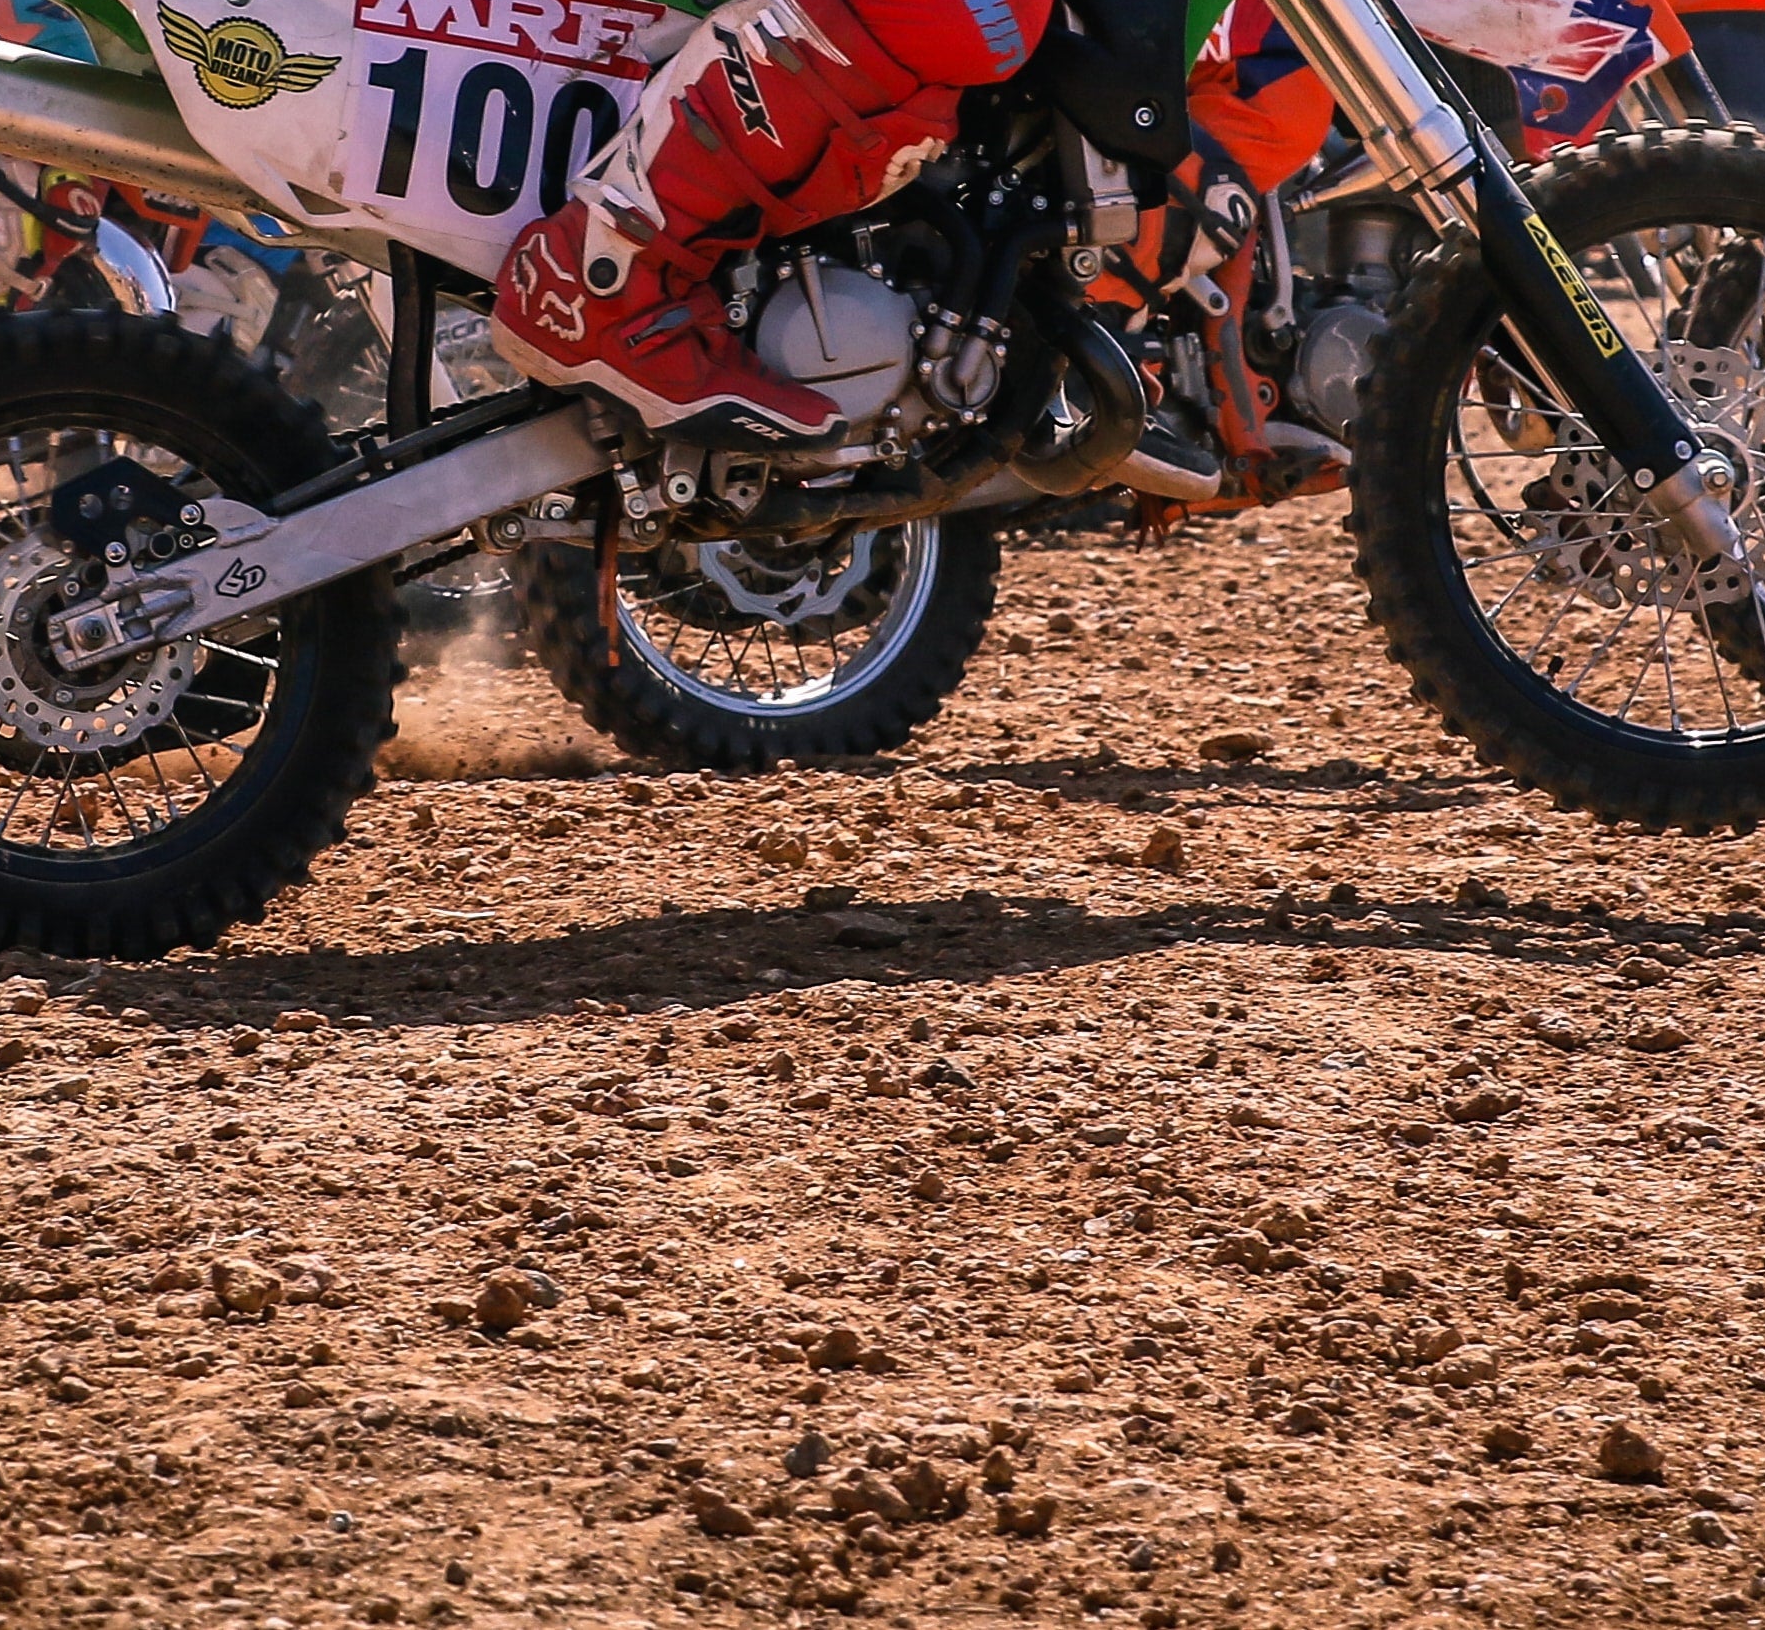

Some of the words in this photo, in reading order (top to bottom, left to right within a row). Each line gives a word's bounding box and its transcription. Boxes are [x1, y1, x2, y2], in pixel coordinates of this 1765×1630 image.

[214, 37, 273, 73] MOTO
[713, 22, 784, 150] FOX
[367, 47, 621, 218] 100
[1528, 222, 1615, 350] ACERBIS
[730, 416, 791, 442] FOX
[215, 557, 267, 599] 6D
